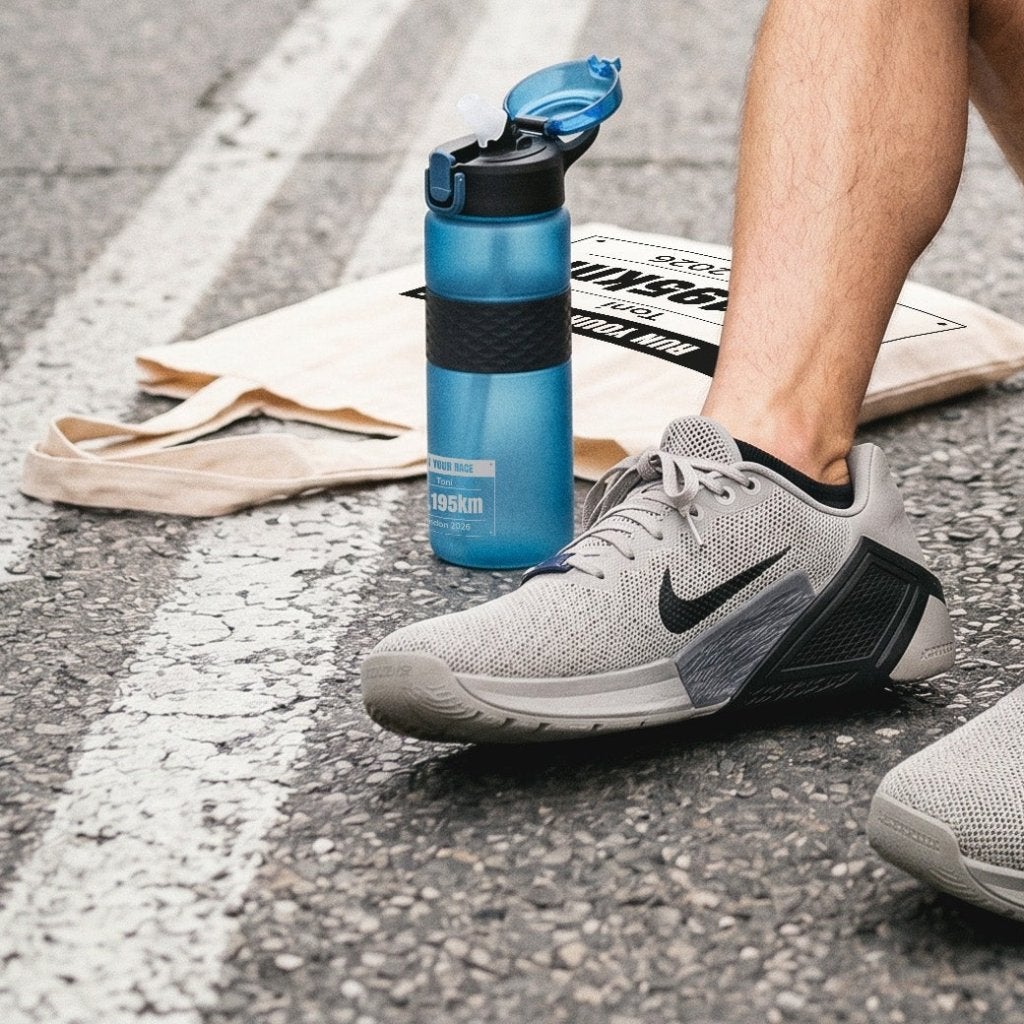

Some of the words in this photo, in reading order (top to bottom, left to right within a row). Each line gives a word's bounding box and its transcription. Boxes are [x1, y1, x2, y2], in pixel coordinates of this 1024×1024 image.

[648, 255, 731, 275] 2026
[594, 301, 664, 321] Toni
[630, 333, 700, 356] RUN
[433, 458, 452, 472] YOUR
[437, 477, 453, 486] Toni
